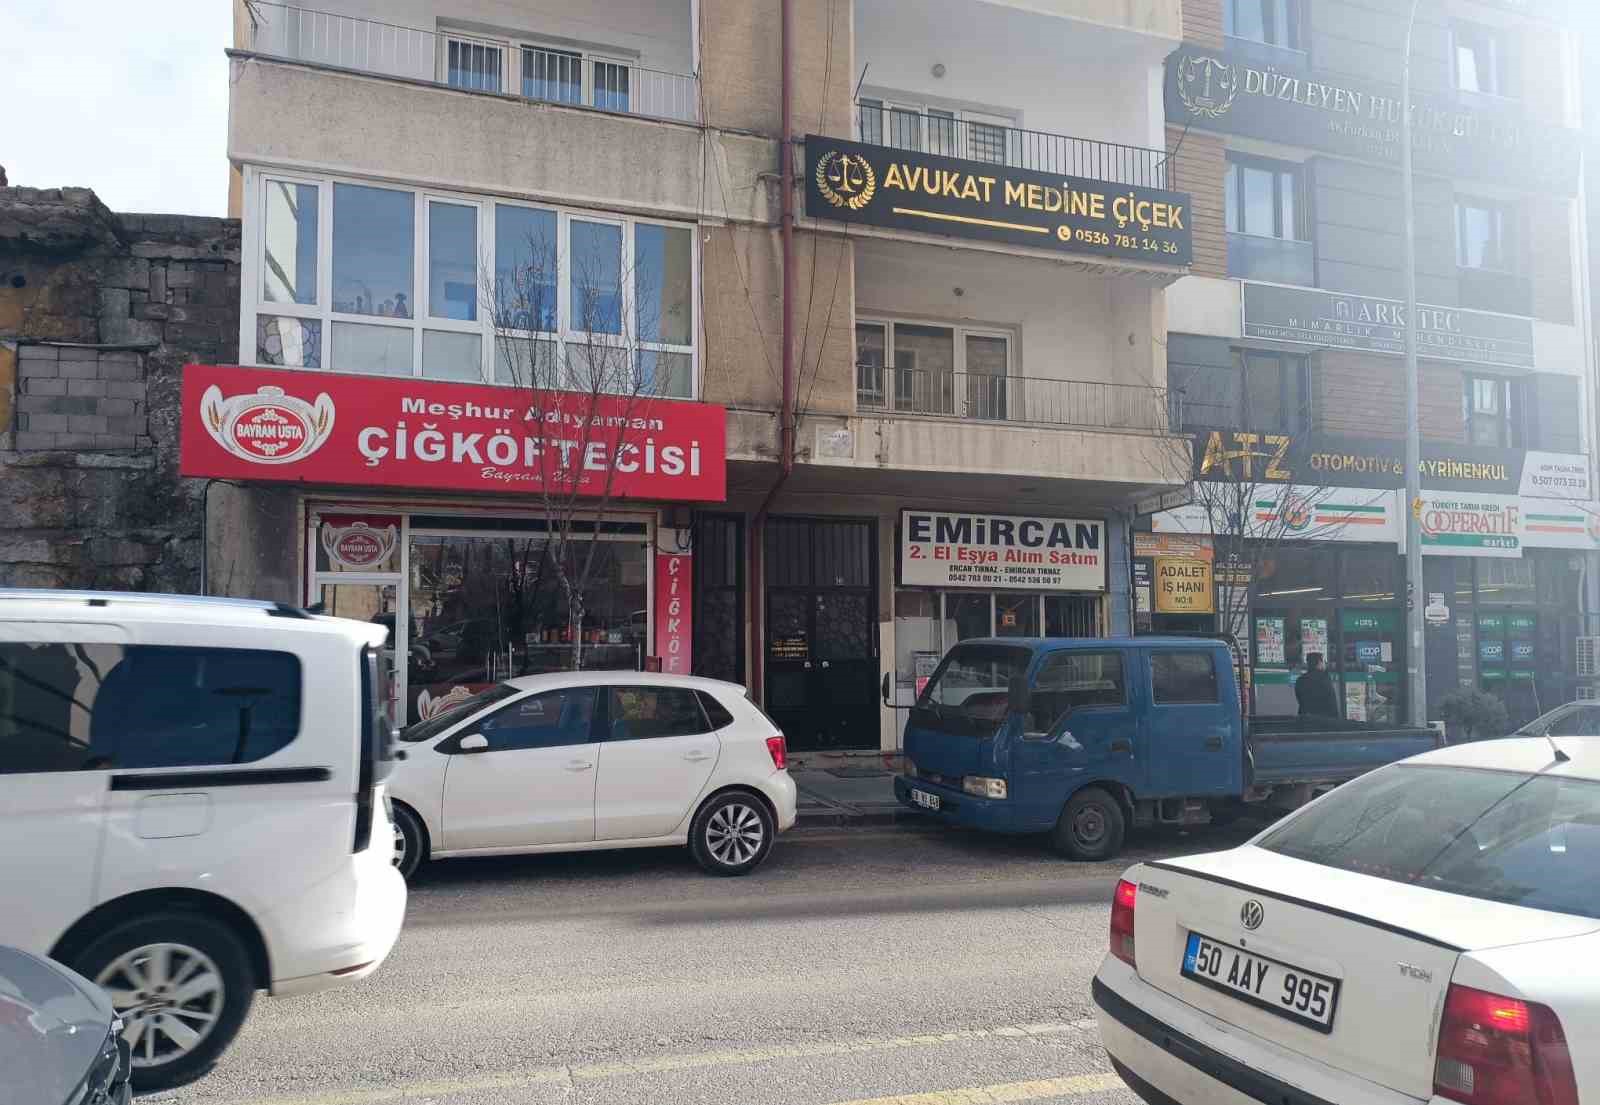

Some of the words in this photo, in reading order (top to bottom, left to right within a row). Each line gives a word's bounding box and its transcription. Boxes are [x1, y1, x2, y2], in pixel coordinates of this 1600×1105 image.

[1245, 64, 1362, 117] DÜZLEYEN
[883, 163, 997, 203] AVUKAT
[1005, 180, 1105, 219] MEDİNE
[1112, 191, 1185, 232] ÇİÇEK
[1075, 229, 1109, 245] 0536
[1114, 234, 1138, 249] 781
[1142, 238, 1160, 252] 14
[401, 397, 514, 420] Meşhur
[237, 423, 276, 438] BAYRAM
[278, 425, 303, 439] USTA
[357, 420, 700, 476] ÇİĞKÖFTECİSİ
[1418, 458, 1509, 481] AYRİMENKUL
[340, 543, 363, 553] BAYRAM
[910, 545, 927, 559] 2.
[934, 546, 950, 560] El
[957, 547, 998, 565] Eşya
[1005, 549, 1042, 563] Alım
[1049, 551, 1098, 566] Satım
[1160, 566, 1206, 577] ADALET
[1177, 582, 1205, 593] HANI
[1197, 942, 1222, 976] 50
[1227, 954, 1270, 994] AAY
[1281, 973, 1330, 1017] 995
